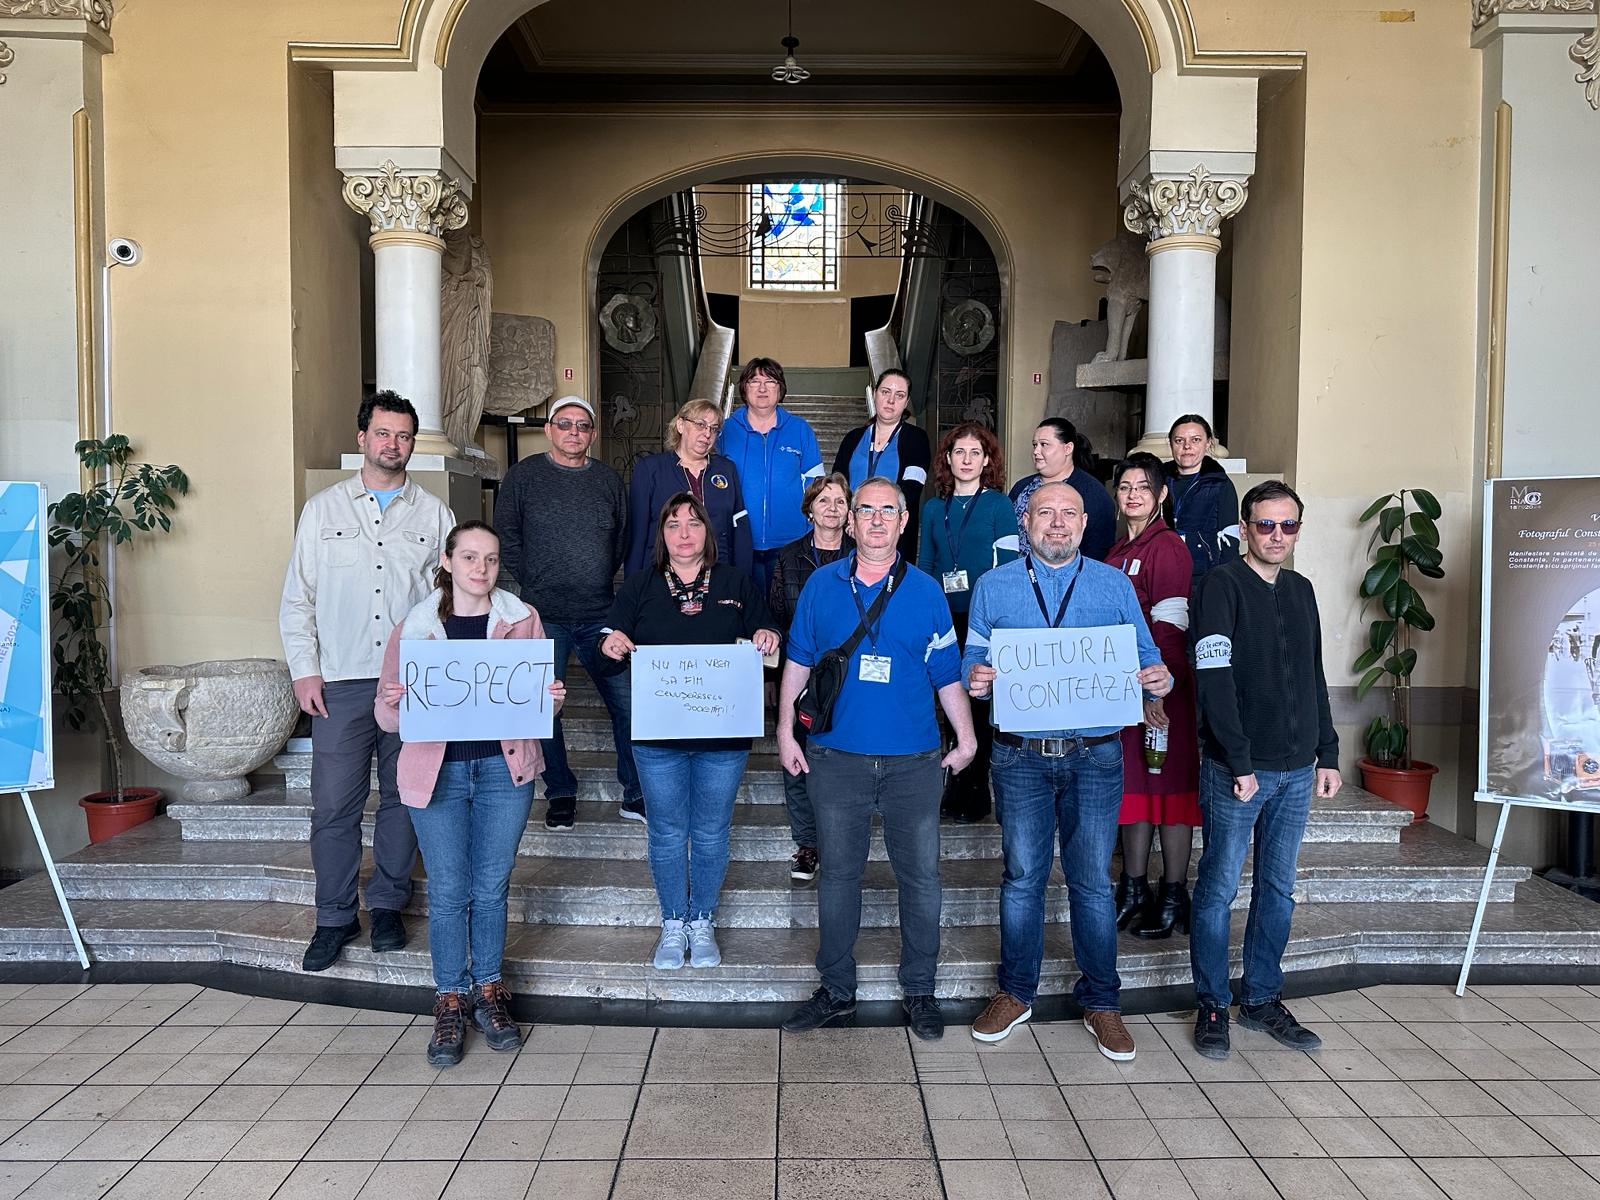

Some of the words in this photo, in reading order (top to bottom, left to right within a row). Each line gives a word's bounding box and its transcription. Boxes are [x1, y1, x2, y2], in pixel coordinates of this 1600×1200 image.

[1518, 528, 1571, 540] Fotograful
[651, 659, 670, 670] NU
[679, 659, 698, 671] MAI
[705, 658, 731, 668] VREM
[998, 635, 1117, 674] CULTURA
[405, 660, 554, 713] RESPECT
[684, 676, 703, 686] FIM
[1009, 668, 1138, 712] CONTEAZĂ
